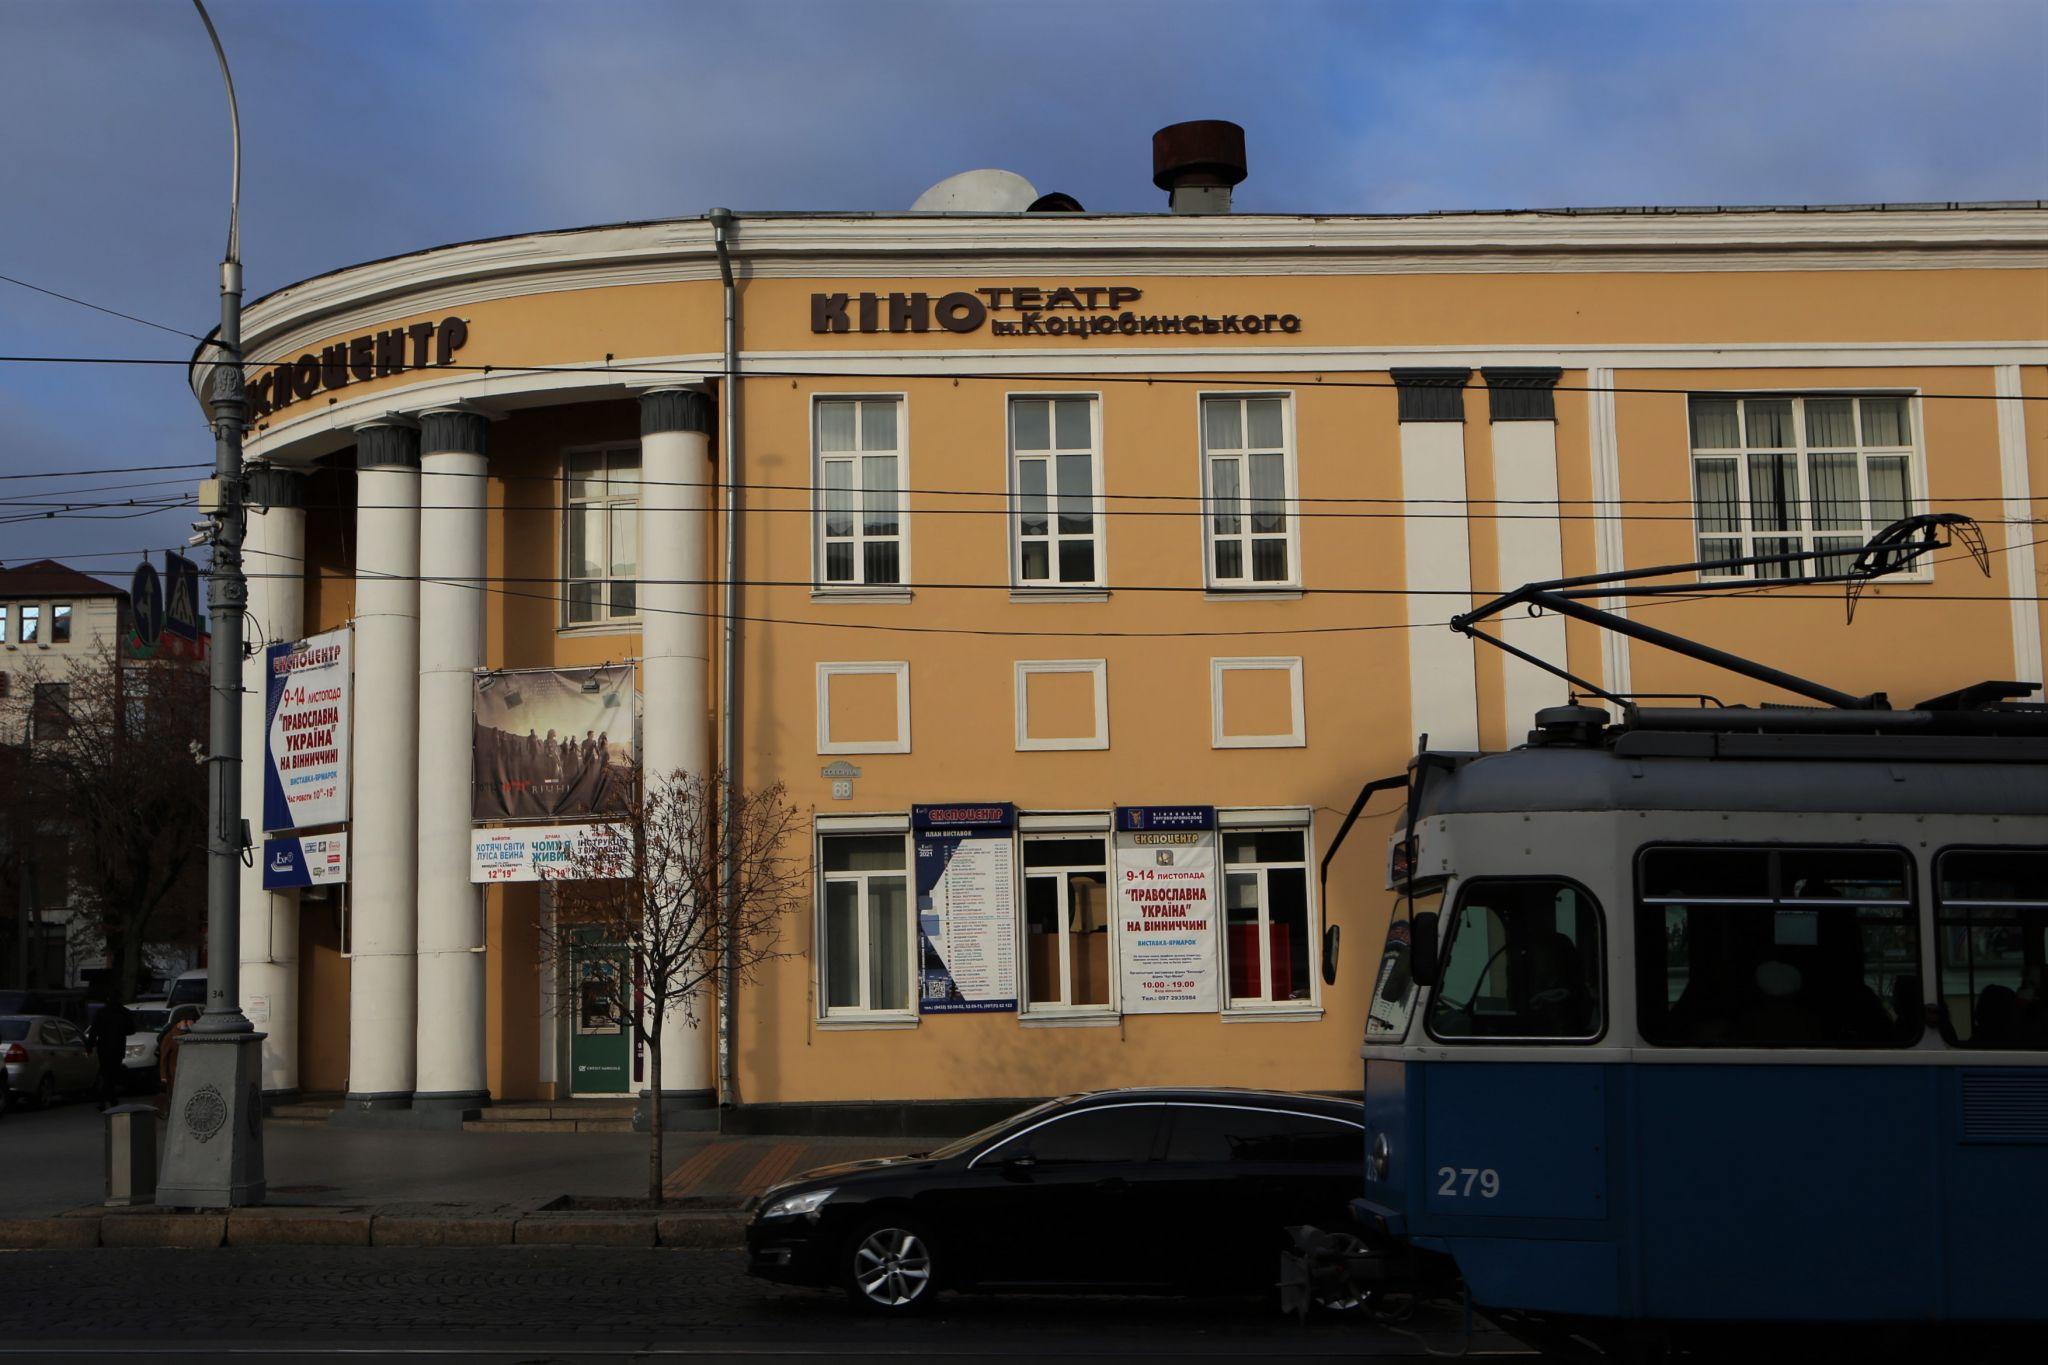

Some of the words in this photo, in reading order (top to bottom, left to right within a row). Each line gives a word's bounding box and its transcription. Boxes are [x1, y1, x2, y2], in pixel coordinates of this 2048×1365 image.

[1021, 311, 1301, 340] Коцюбинського
[242, 316, 468, 424] КСПОЦЕНТР
[284, 686, 305, 708] 9-14
[279, 706, 339, 732] "ПРАВОСЛАВНА
[286, 724, 336, 752] УКРАЇНА"
[280, 756, 291, 771] НА
[292, 748, 338, 769] ВІННИЧЧИНІ
[834, 782, 850, 797] 68
[943, 830, 973, 838] ВИСТАВОК
[476, 842, 502, 853] КОТЯЧІ
[503, 842, 525, 852] СВІТИ
[919, 850, 933, 858] 2021
[1126, 869, 1155, 882] 9-14
[1157, 872, 1206, 881] ЛИСТОПАДА
[1125, 888, 1207, 902] "ПРАВОСЛАВНА
[1141, 902, 1192, 918] УКРАЇНА"
[1127, 921, 1141, 932] НА
[1144, 920, 1207, 931] ВІННИЧЧИНІ
[1137, 939, 1197, 947] ВИСТАВКА-ЯРМАРОК
[1142, 981, 1165, 989] 10.00
[1437, 1166, 1500, 1198] 279
